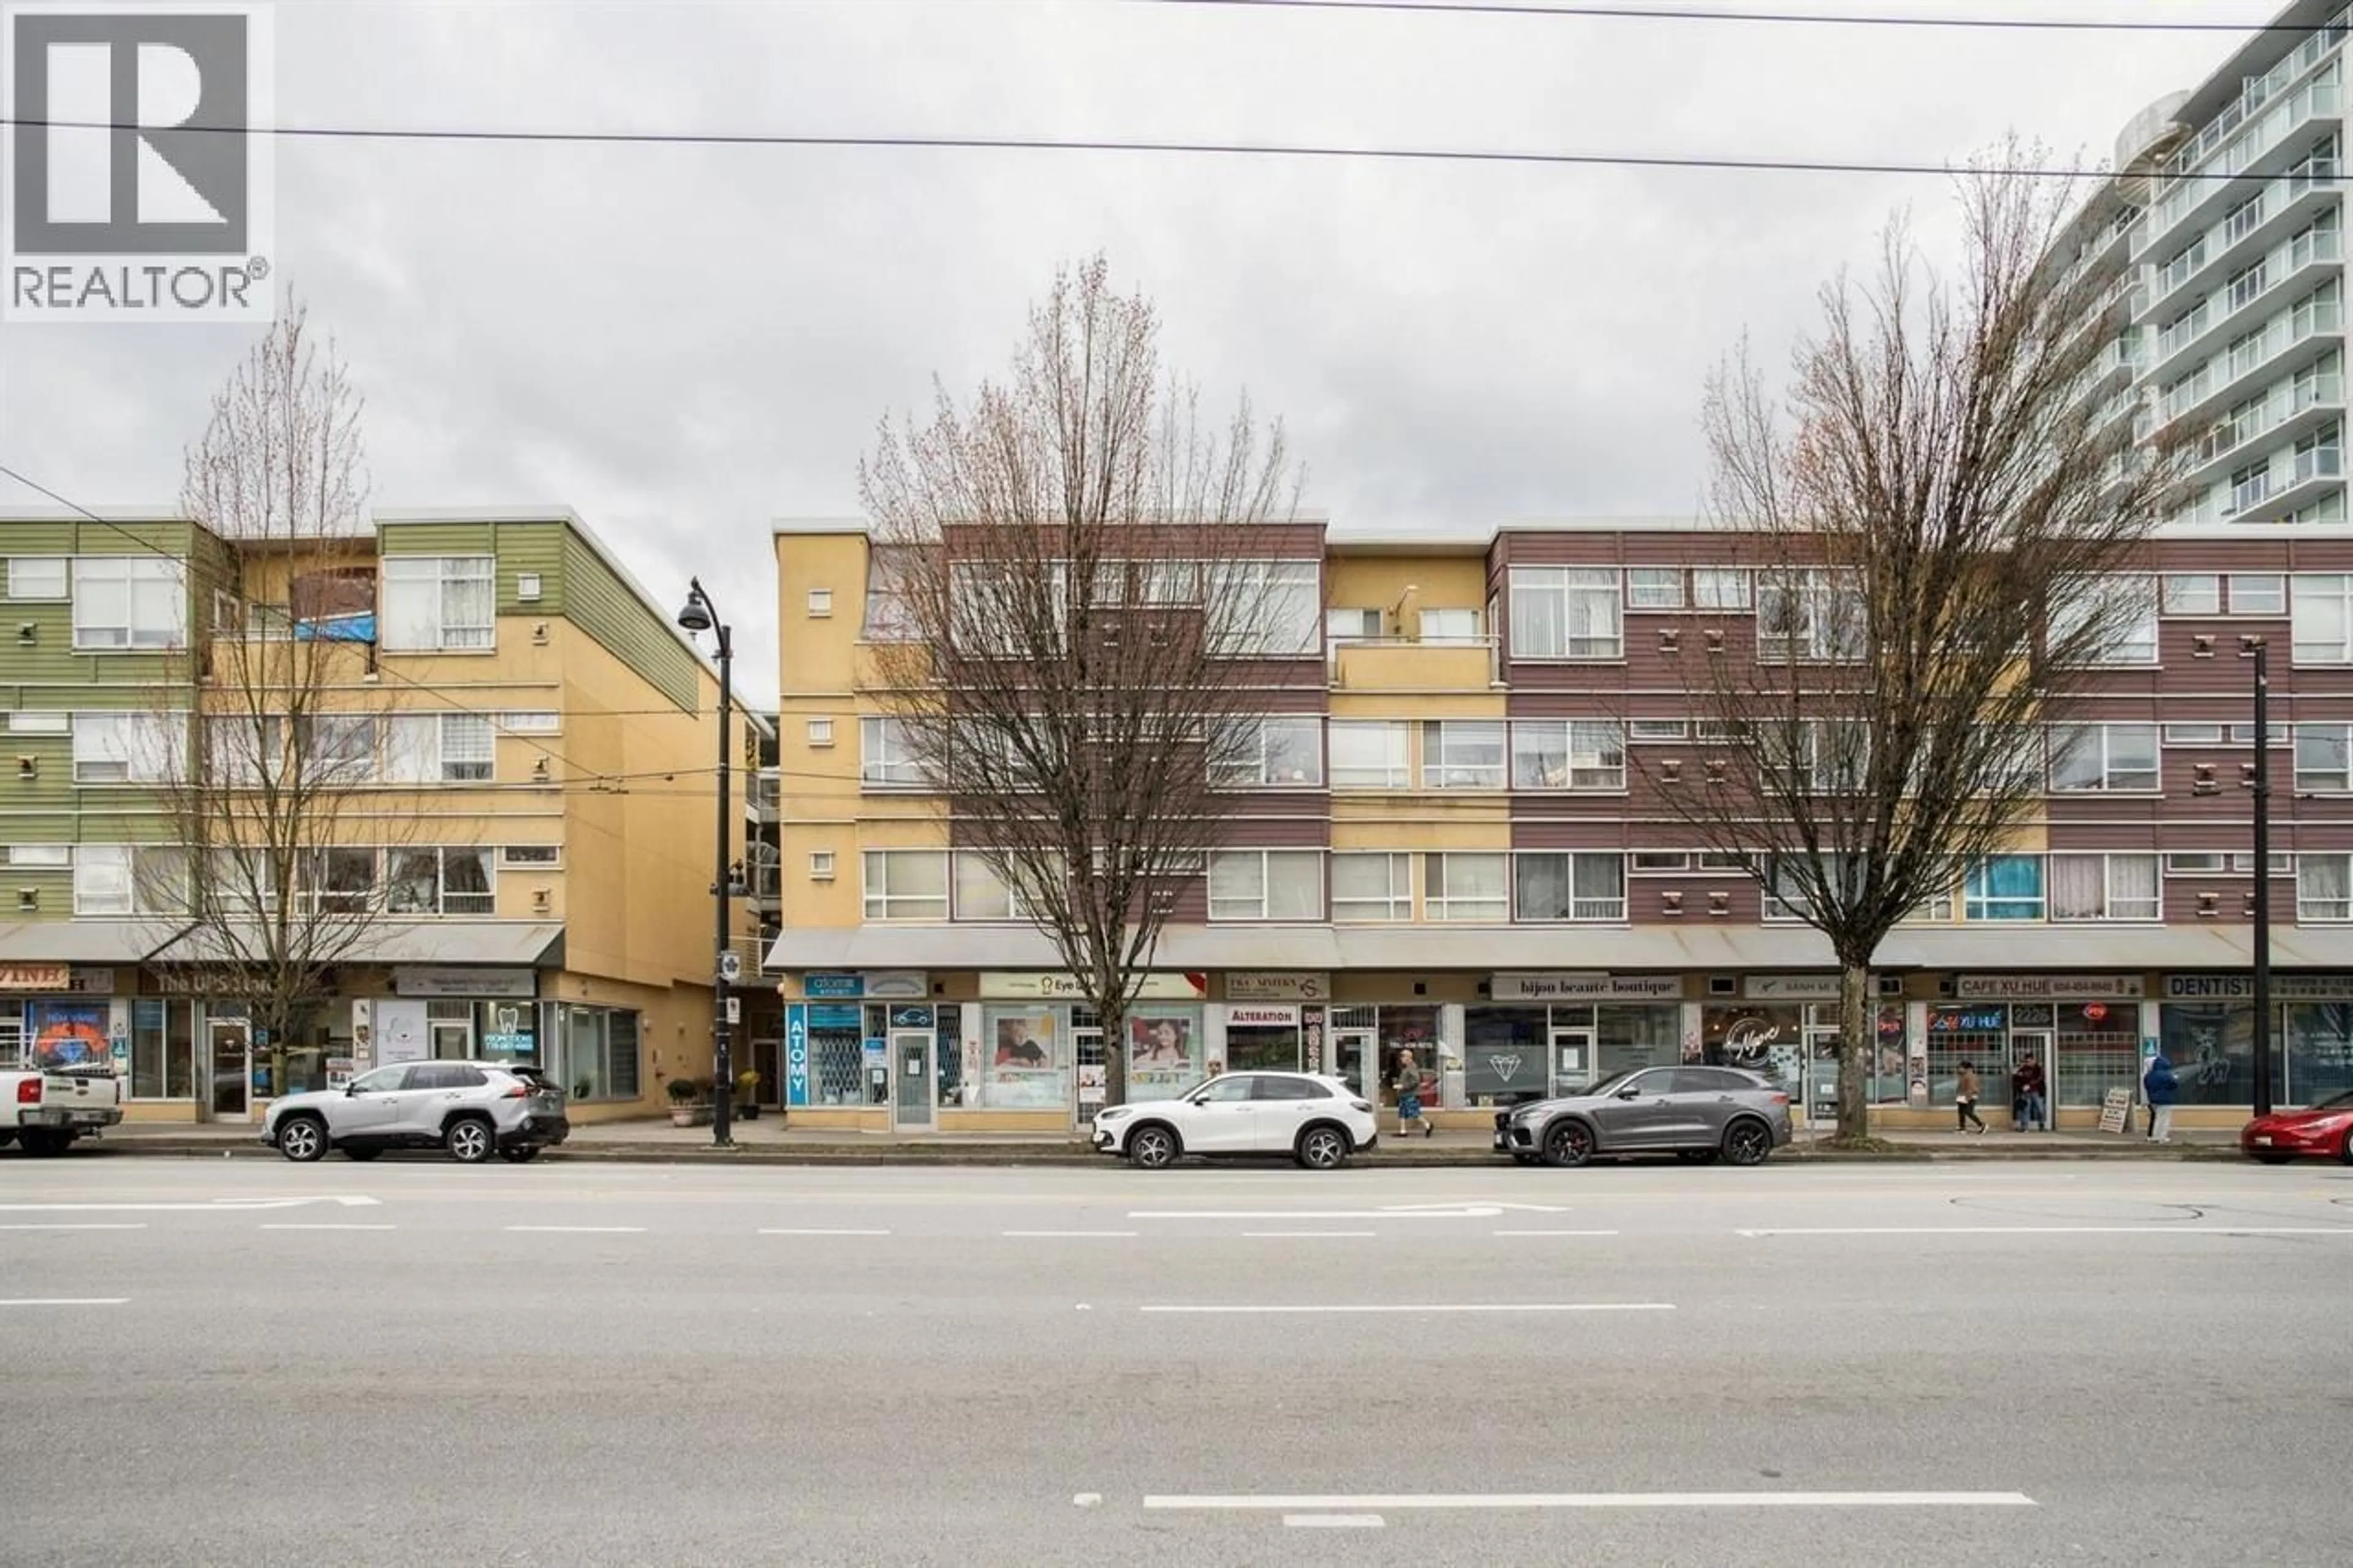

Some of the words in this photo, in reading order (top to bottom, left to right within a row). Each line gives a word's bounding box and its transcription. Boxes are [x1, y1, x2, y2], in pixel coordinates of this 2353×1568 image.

[1055, 980, 1074, 993] Eye
[1521, 980, 1555, 996] bijou
[1613, 980, 1675, 996] boutique
[2172, 979, 2254, 994] DENTIST
[1232, 1010, 1292, 1022] ALTERATION
[790, 1020, 805, 1091] ATOMY
